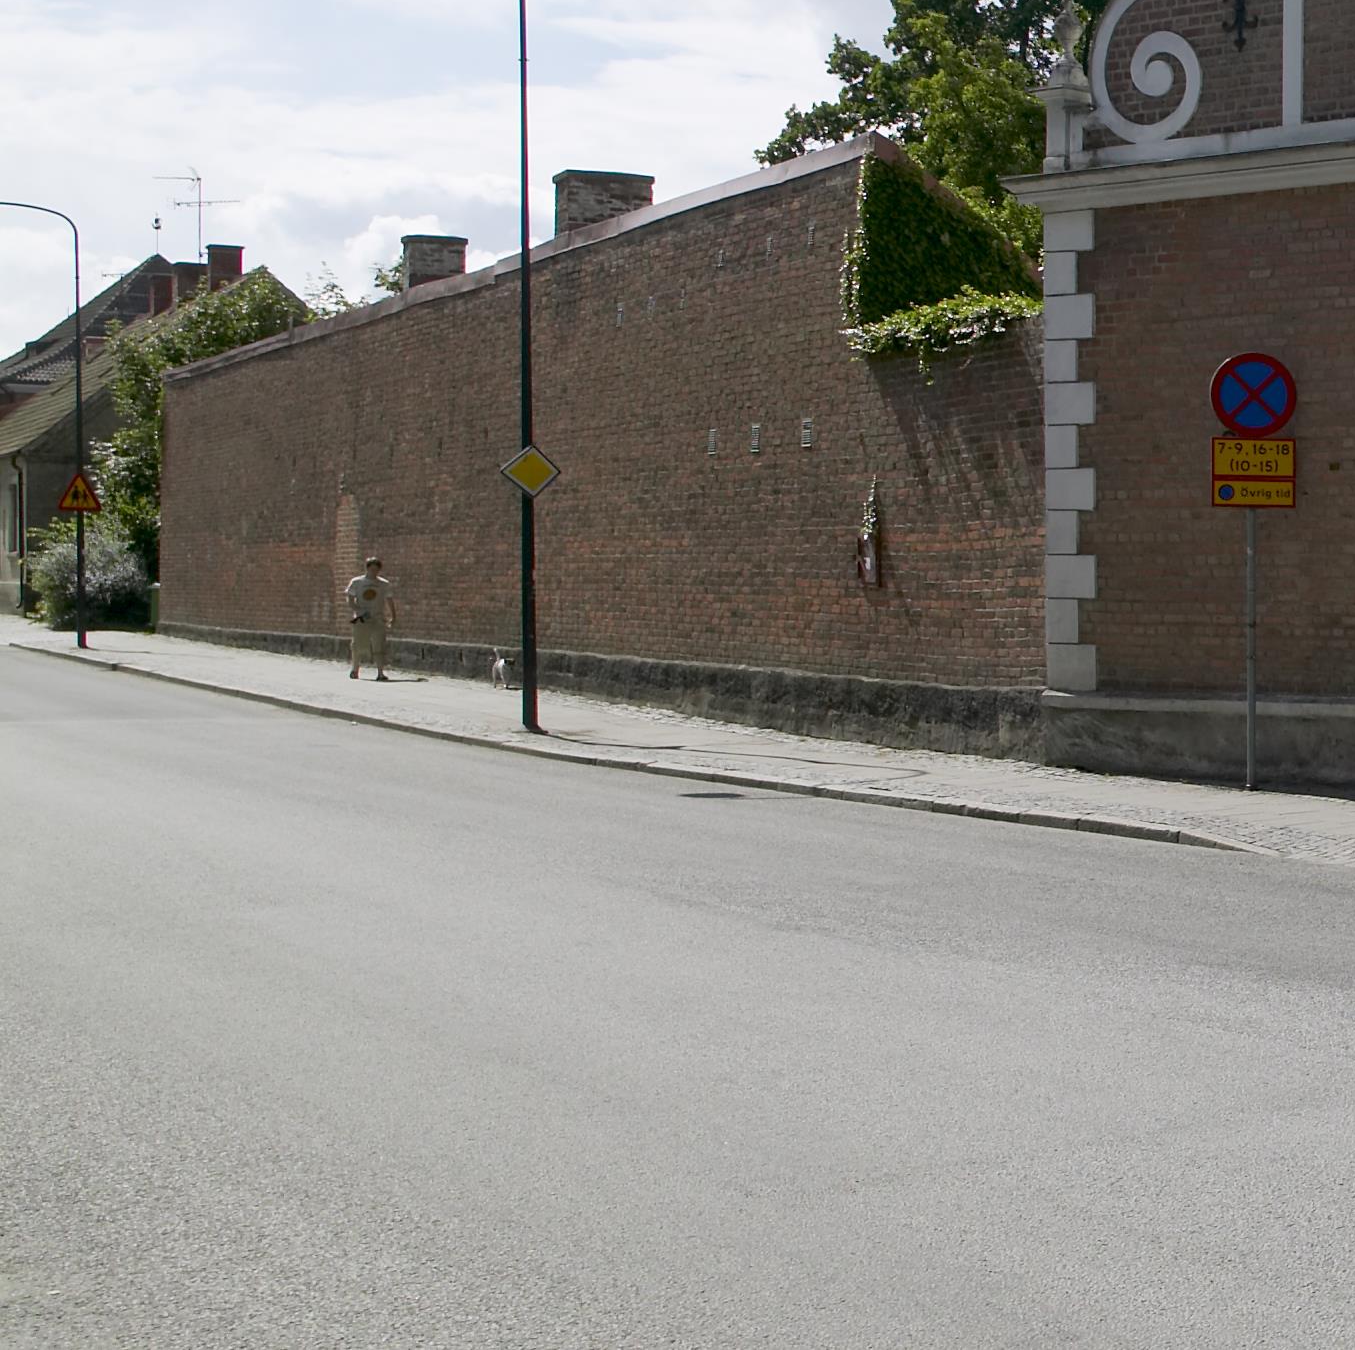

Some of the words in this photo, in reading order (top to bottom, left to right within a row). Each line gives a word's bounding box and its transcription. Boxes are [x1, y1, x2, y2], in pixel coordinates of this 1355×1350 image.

[1230, 458, 1279, 473] (10-15)
[1240, 486, 1272, 500] Övrig
[1275, 488, 1291, 499] tid
